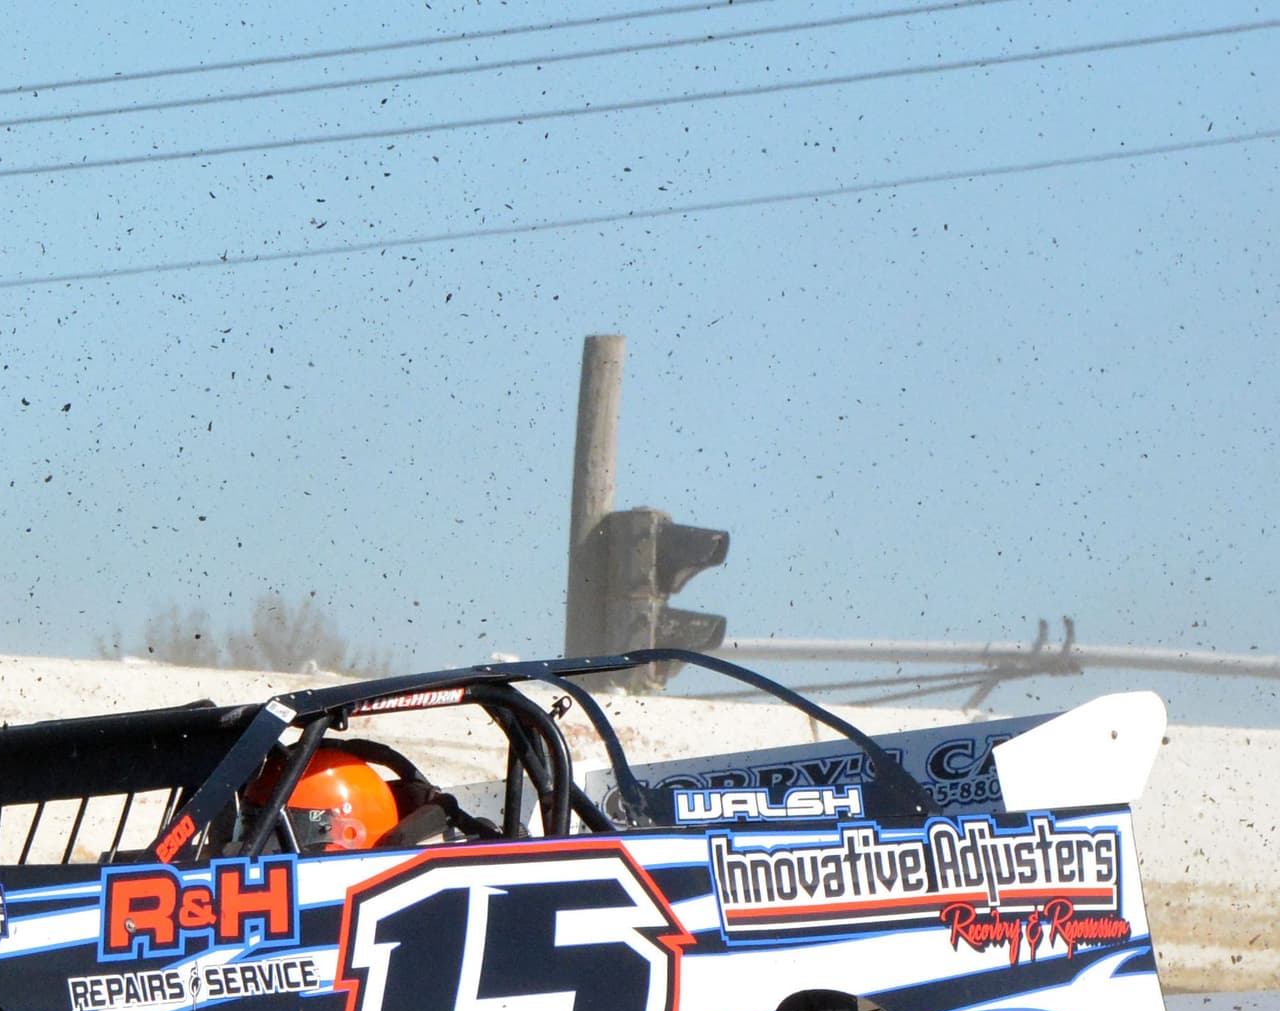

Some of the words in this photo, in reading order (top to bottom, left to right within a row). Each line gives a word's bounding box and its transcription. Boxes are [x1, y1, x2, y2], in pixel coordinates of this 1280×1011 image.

[675, 788, 862, 822] WALSH
[717, 826, 925, 904] Innovative
[938, 822, 1116, 904] Adjusters
[109, 867, 290, 949] R&H
[941, 902, 1020, 965] Recovery
[1043, 898, 1130, 960] Repossession
[70, 970, 186, 1011] REPAIRS
[204, 959, 320, 996] SERVICE
